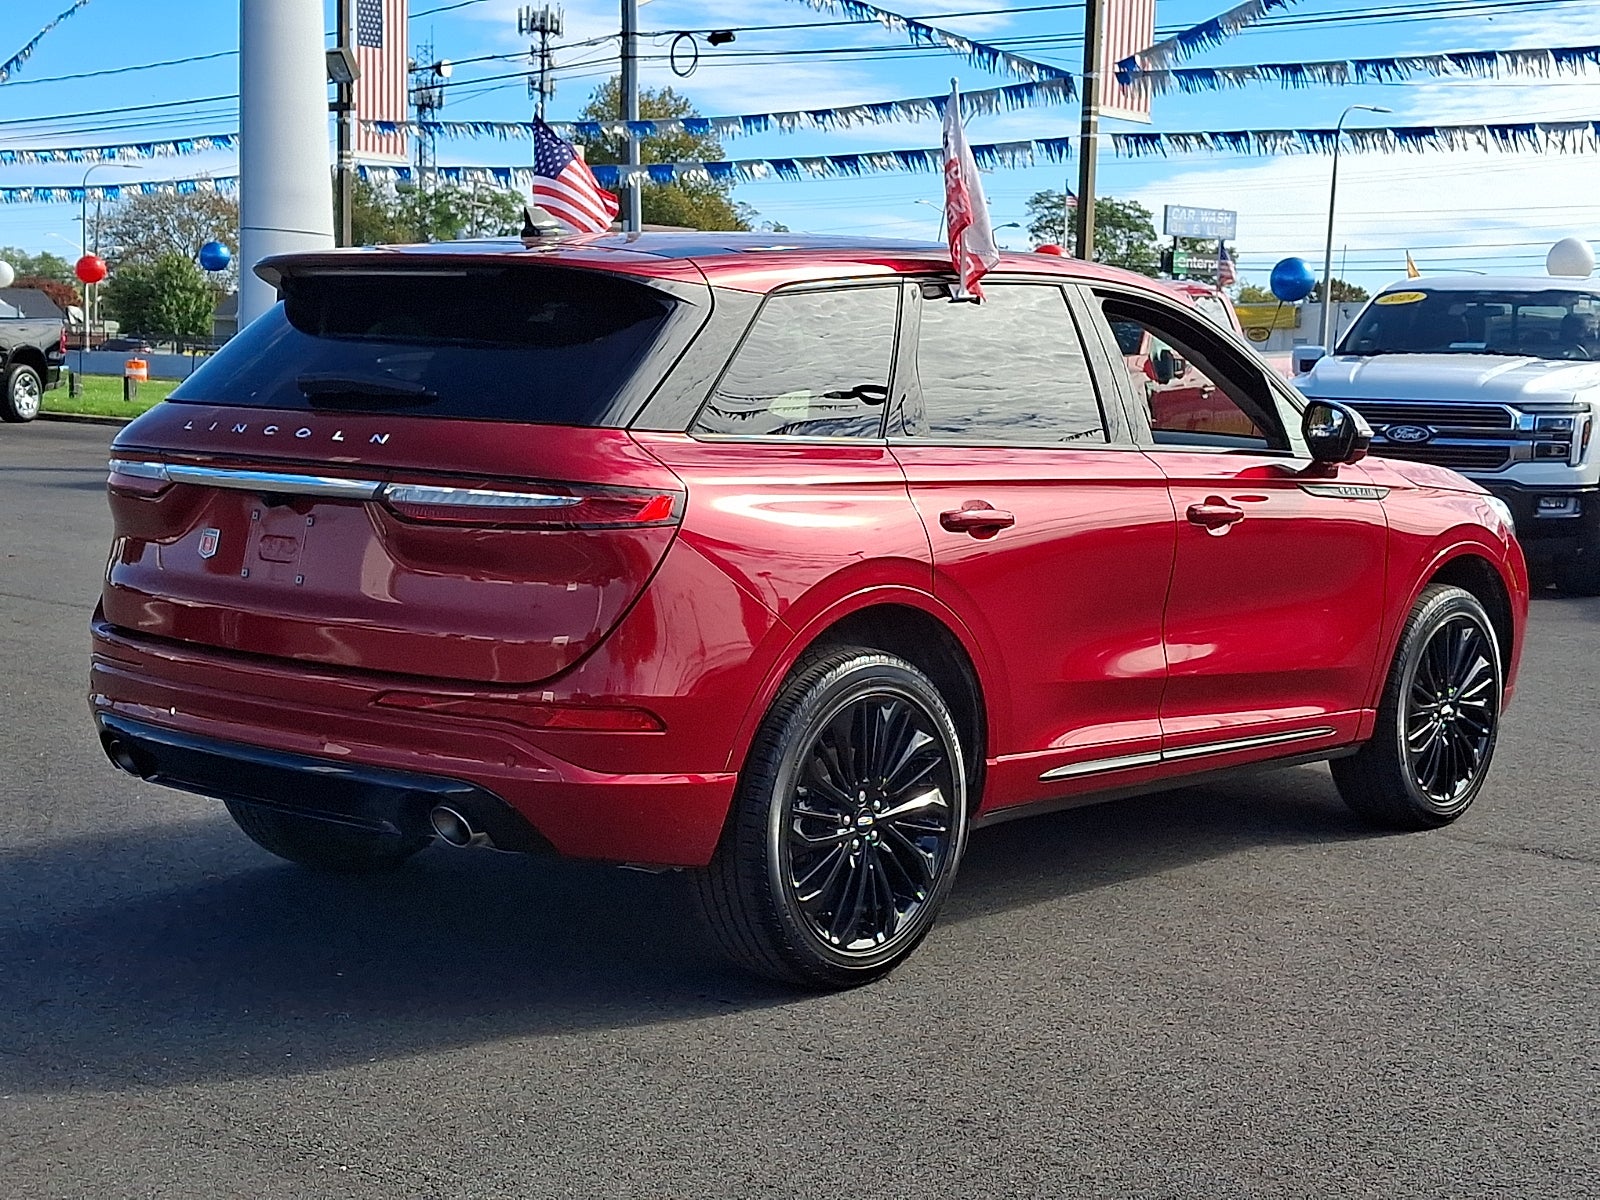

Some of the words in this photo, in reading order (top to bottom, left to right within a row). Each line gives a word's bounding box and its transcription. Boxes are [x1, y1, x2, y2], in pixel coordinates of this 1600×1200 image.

[1171, 208, 1196, 221] CAR
[1200, 210, 1232, 224] WASH
[184, 420, 390, 444] LINCOLN
[1394, 428, 1421, 439] Ford
